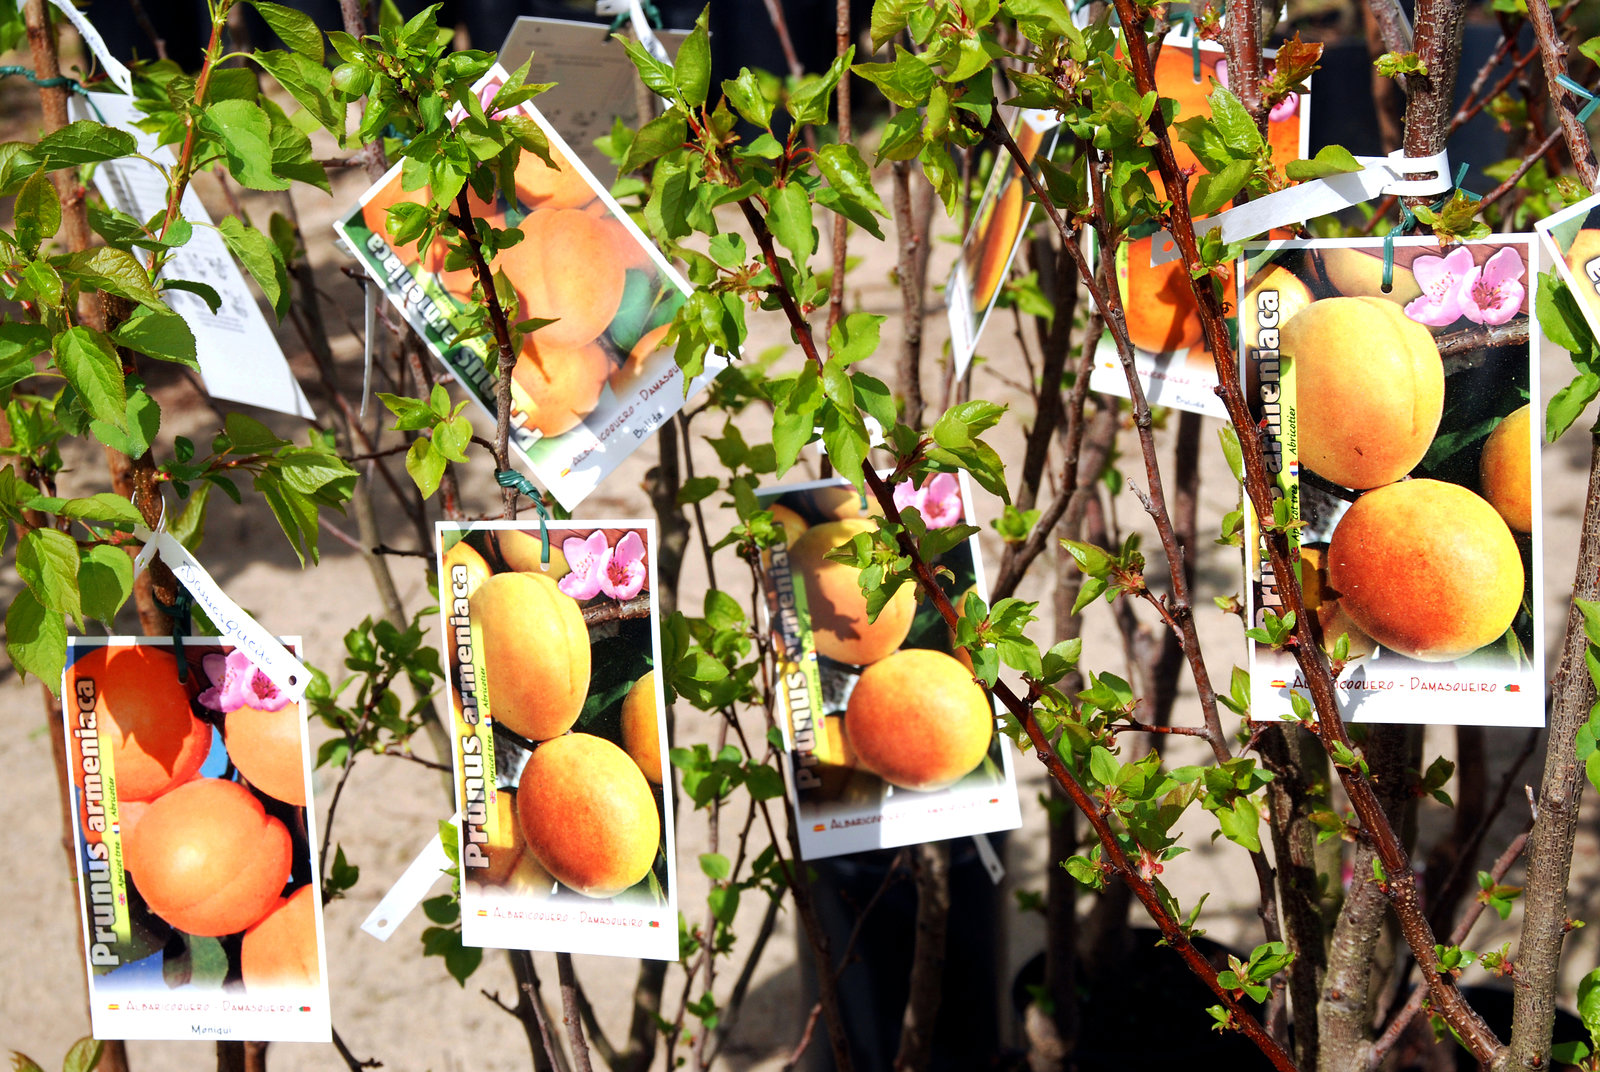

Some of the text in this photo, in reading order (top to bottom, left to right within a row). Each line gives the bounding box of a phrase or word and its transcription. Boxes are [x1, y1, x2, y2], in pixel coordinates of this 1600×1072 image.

[366, 231, 460, 346] armeniaca
[1251, 289, 1283, 475] armeniaca
[1286, 405, 1297, 456] Abricotier
[769, 521, 821, 790] Prunus armeniac
[479, 665, 490, 709] Abricotier
[1292, 675, 1498, 693] ALICOQUERO DAMASQUEIRO
[449, 564, 490, 869] Prunus armeniaca
[487, 734, 499, 786] Apricot tree
[74, 678, 120, 966] Prunus armeniaca
[107, 776, 118, 818] Abricotier
[114, 841, 126, 888] Apricot tree
